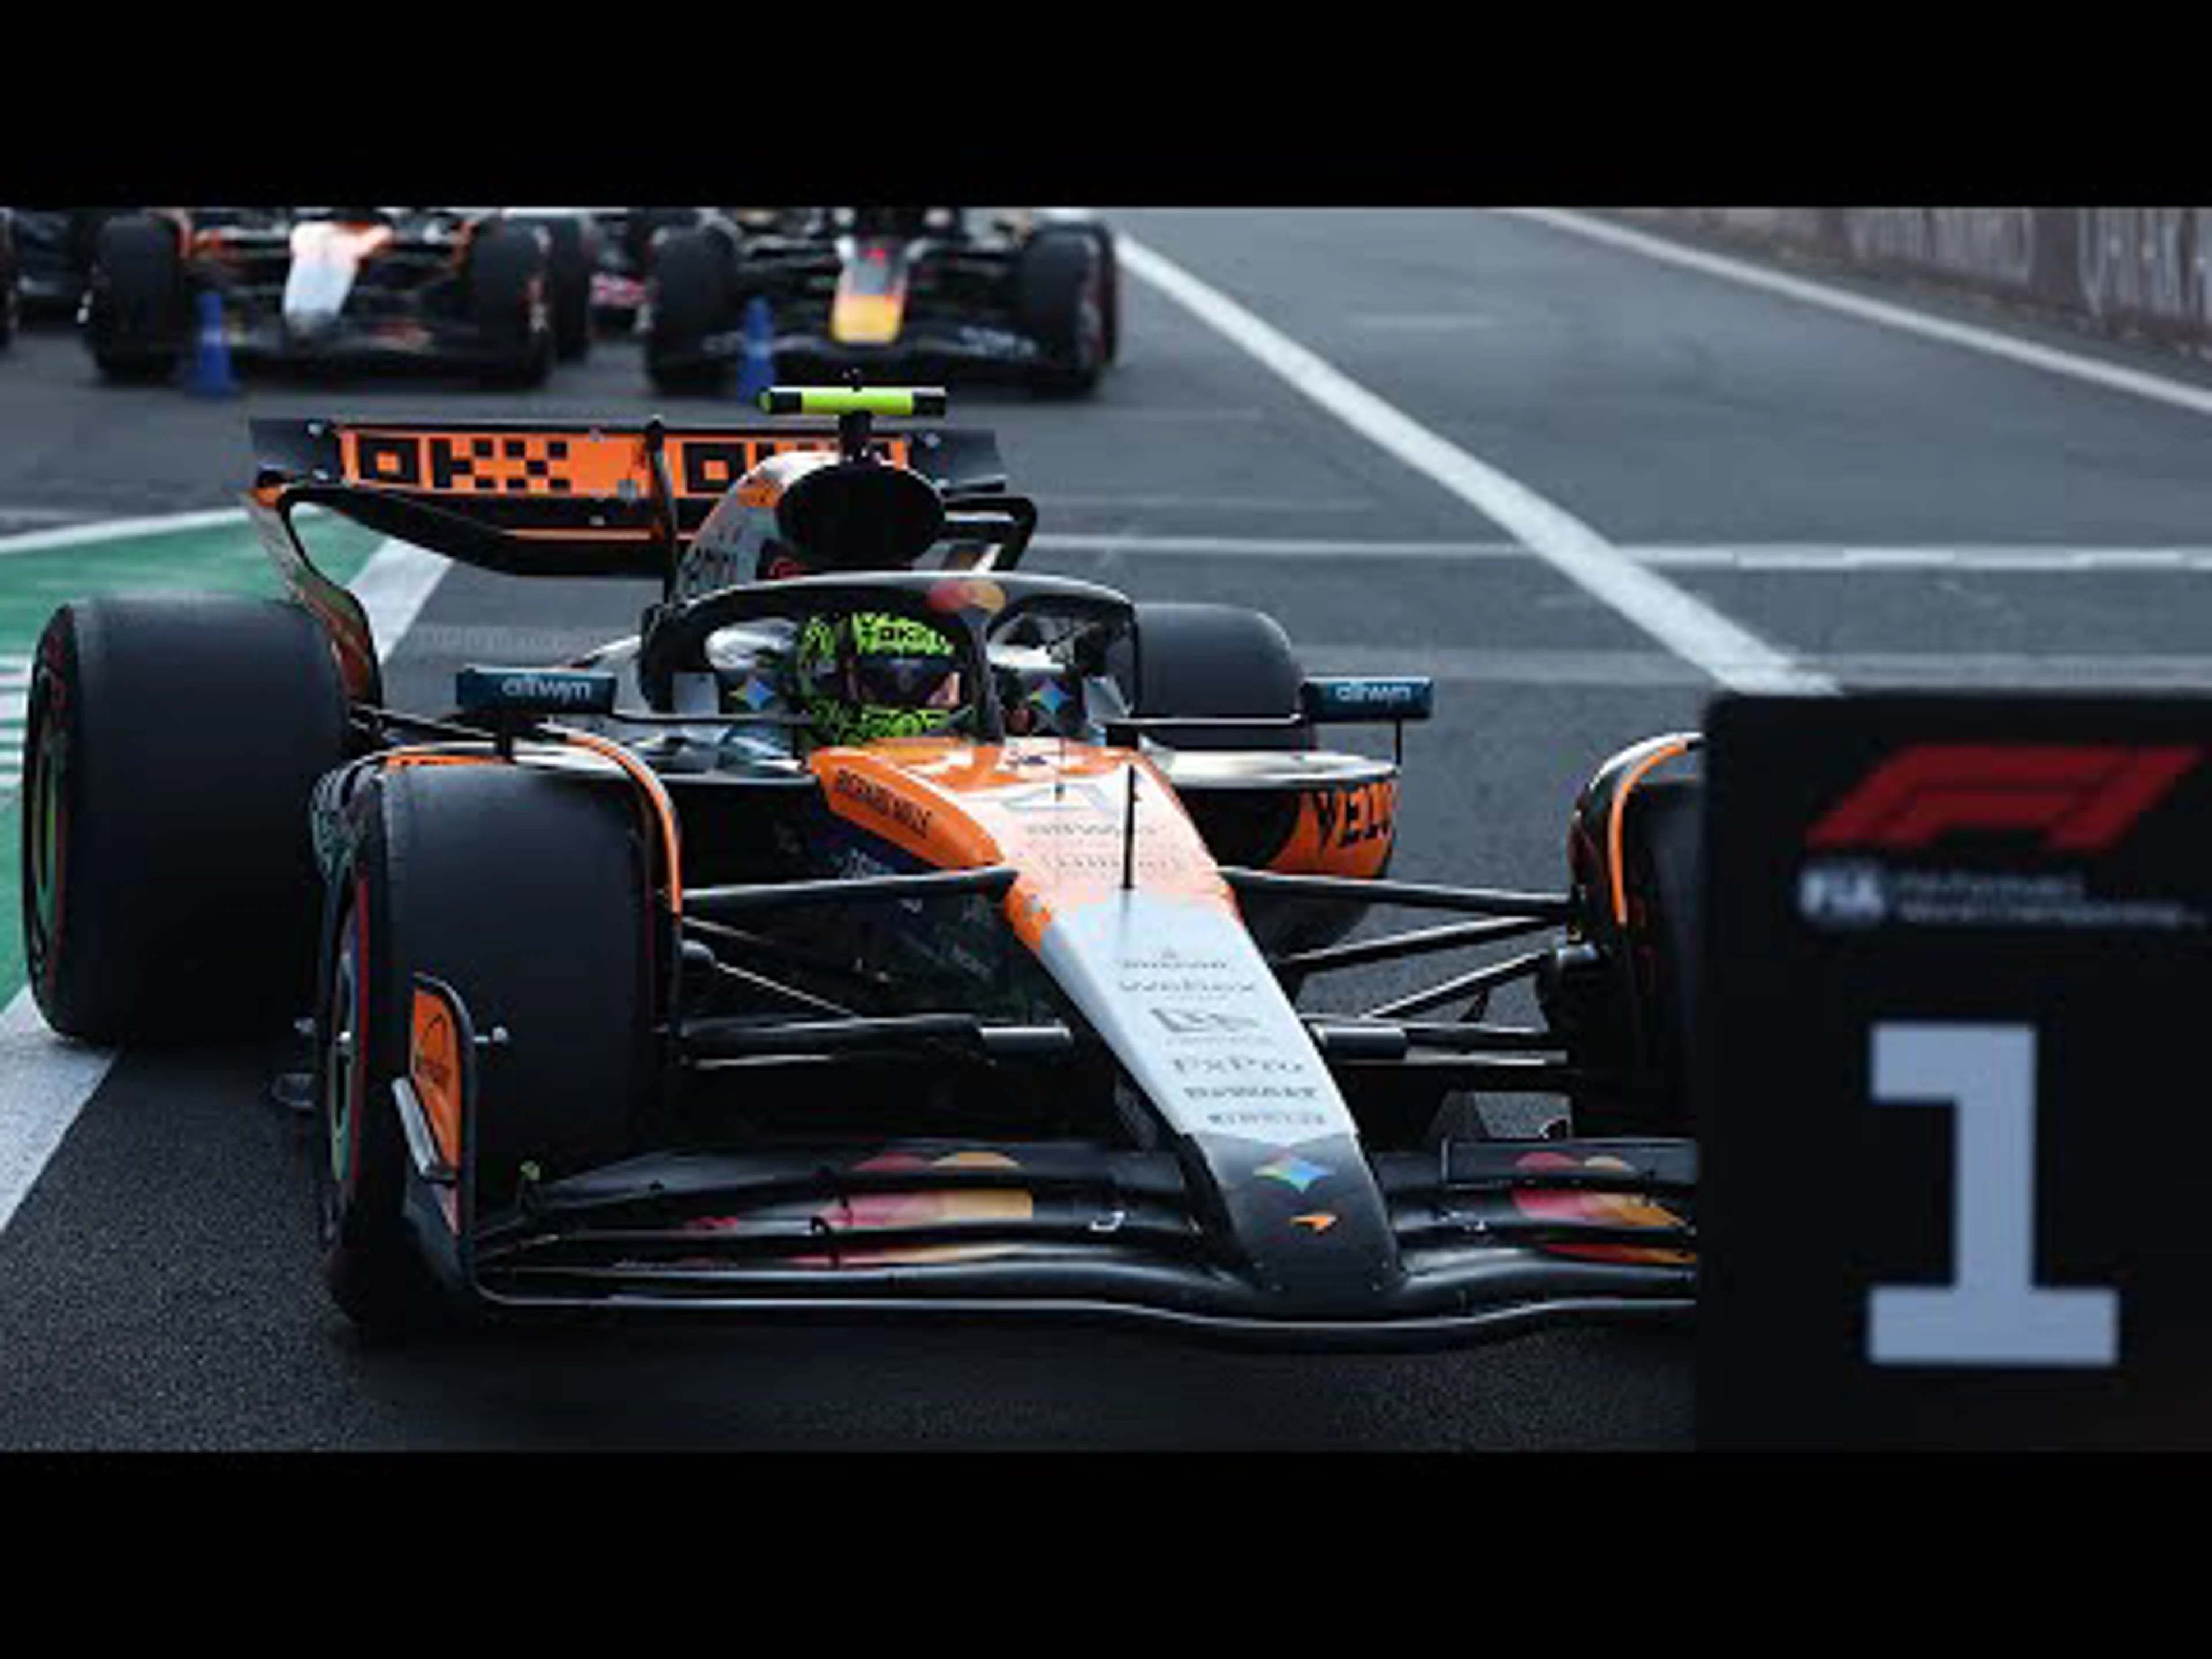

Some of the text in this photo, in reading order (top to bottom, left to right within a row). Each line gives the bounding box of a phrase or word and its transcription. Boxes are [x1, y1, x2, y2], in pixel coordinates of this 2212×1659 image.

[1806, 744, 2203, 849] F1
[1798, 866, 1885, 923] FIA
[1869, 1023, 2119, 1367] 1
